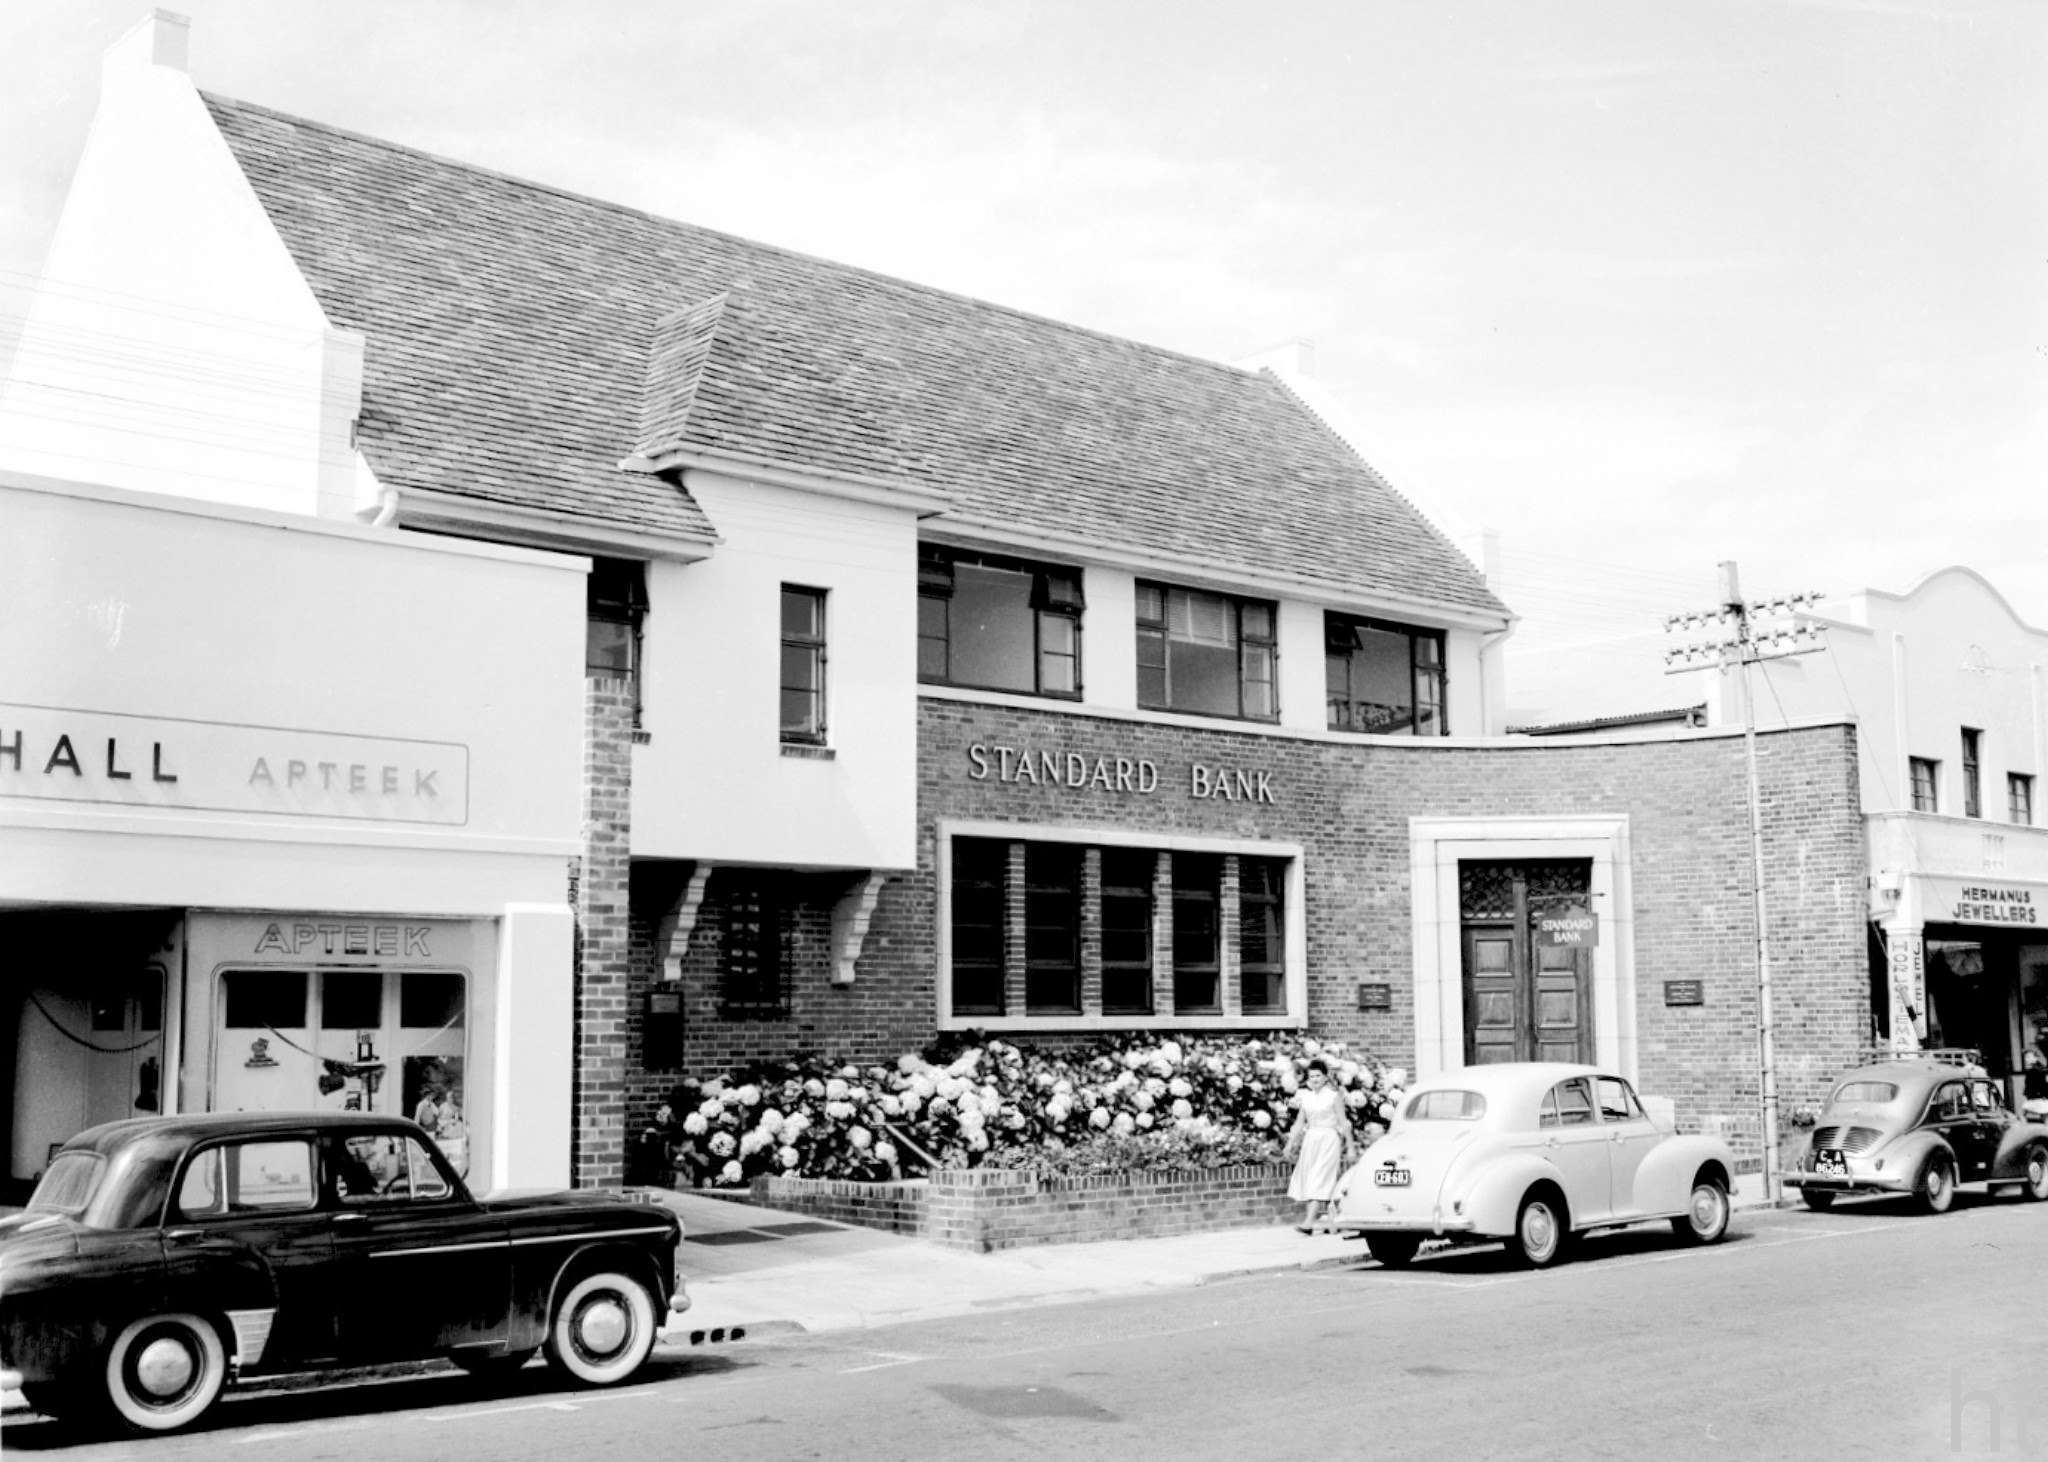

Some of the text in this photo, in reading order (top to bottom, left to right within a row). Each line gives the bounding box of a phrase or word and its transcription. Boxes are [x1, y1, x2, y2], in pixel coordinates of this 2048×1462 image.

[248, 756, 438, 797] APTEEK
[968, 744, 1275, 803] STANDARD BANK
[1961, 887, 2031, 903] HERMANUS
[1952, 902, 2037, 923] JEWELLERS
[1541, 918, 1594, 931] STANDARD
[254, 923, 431, 957] APTEEK
[1553, 931, 1581, 943] BANK
